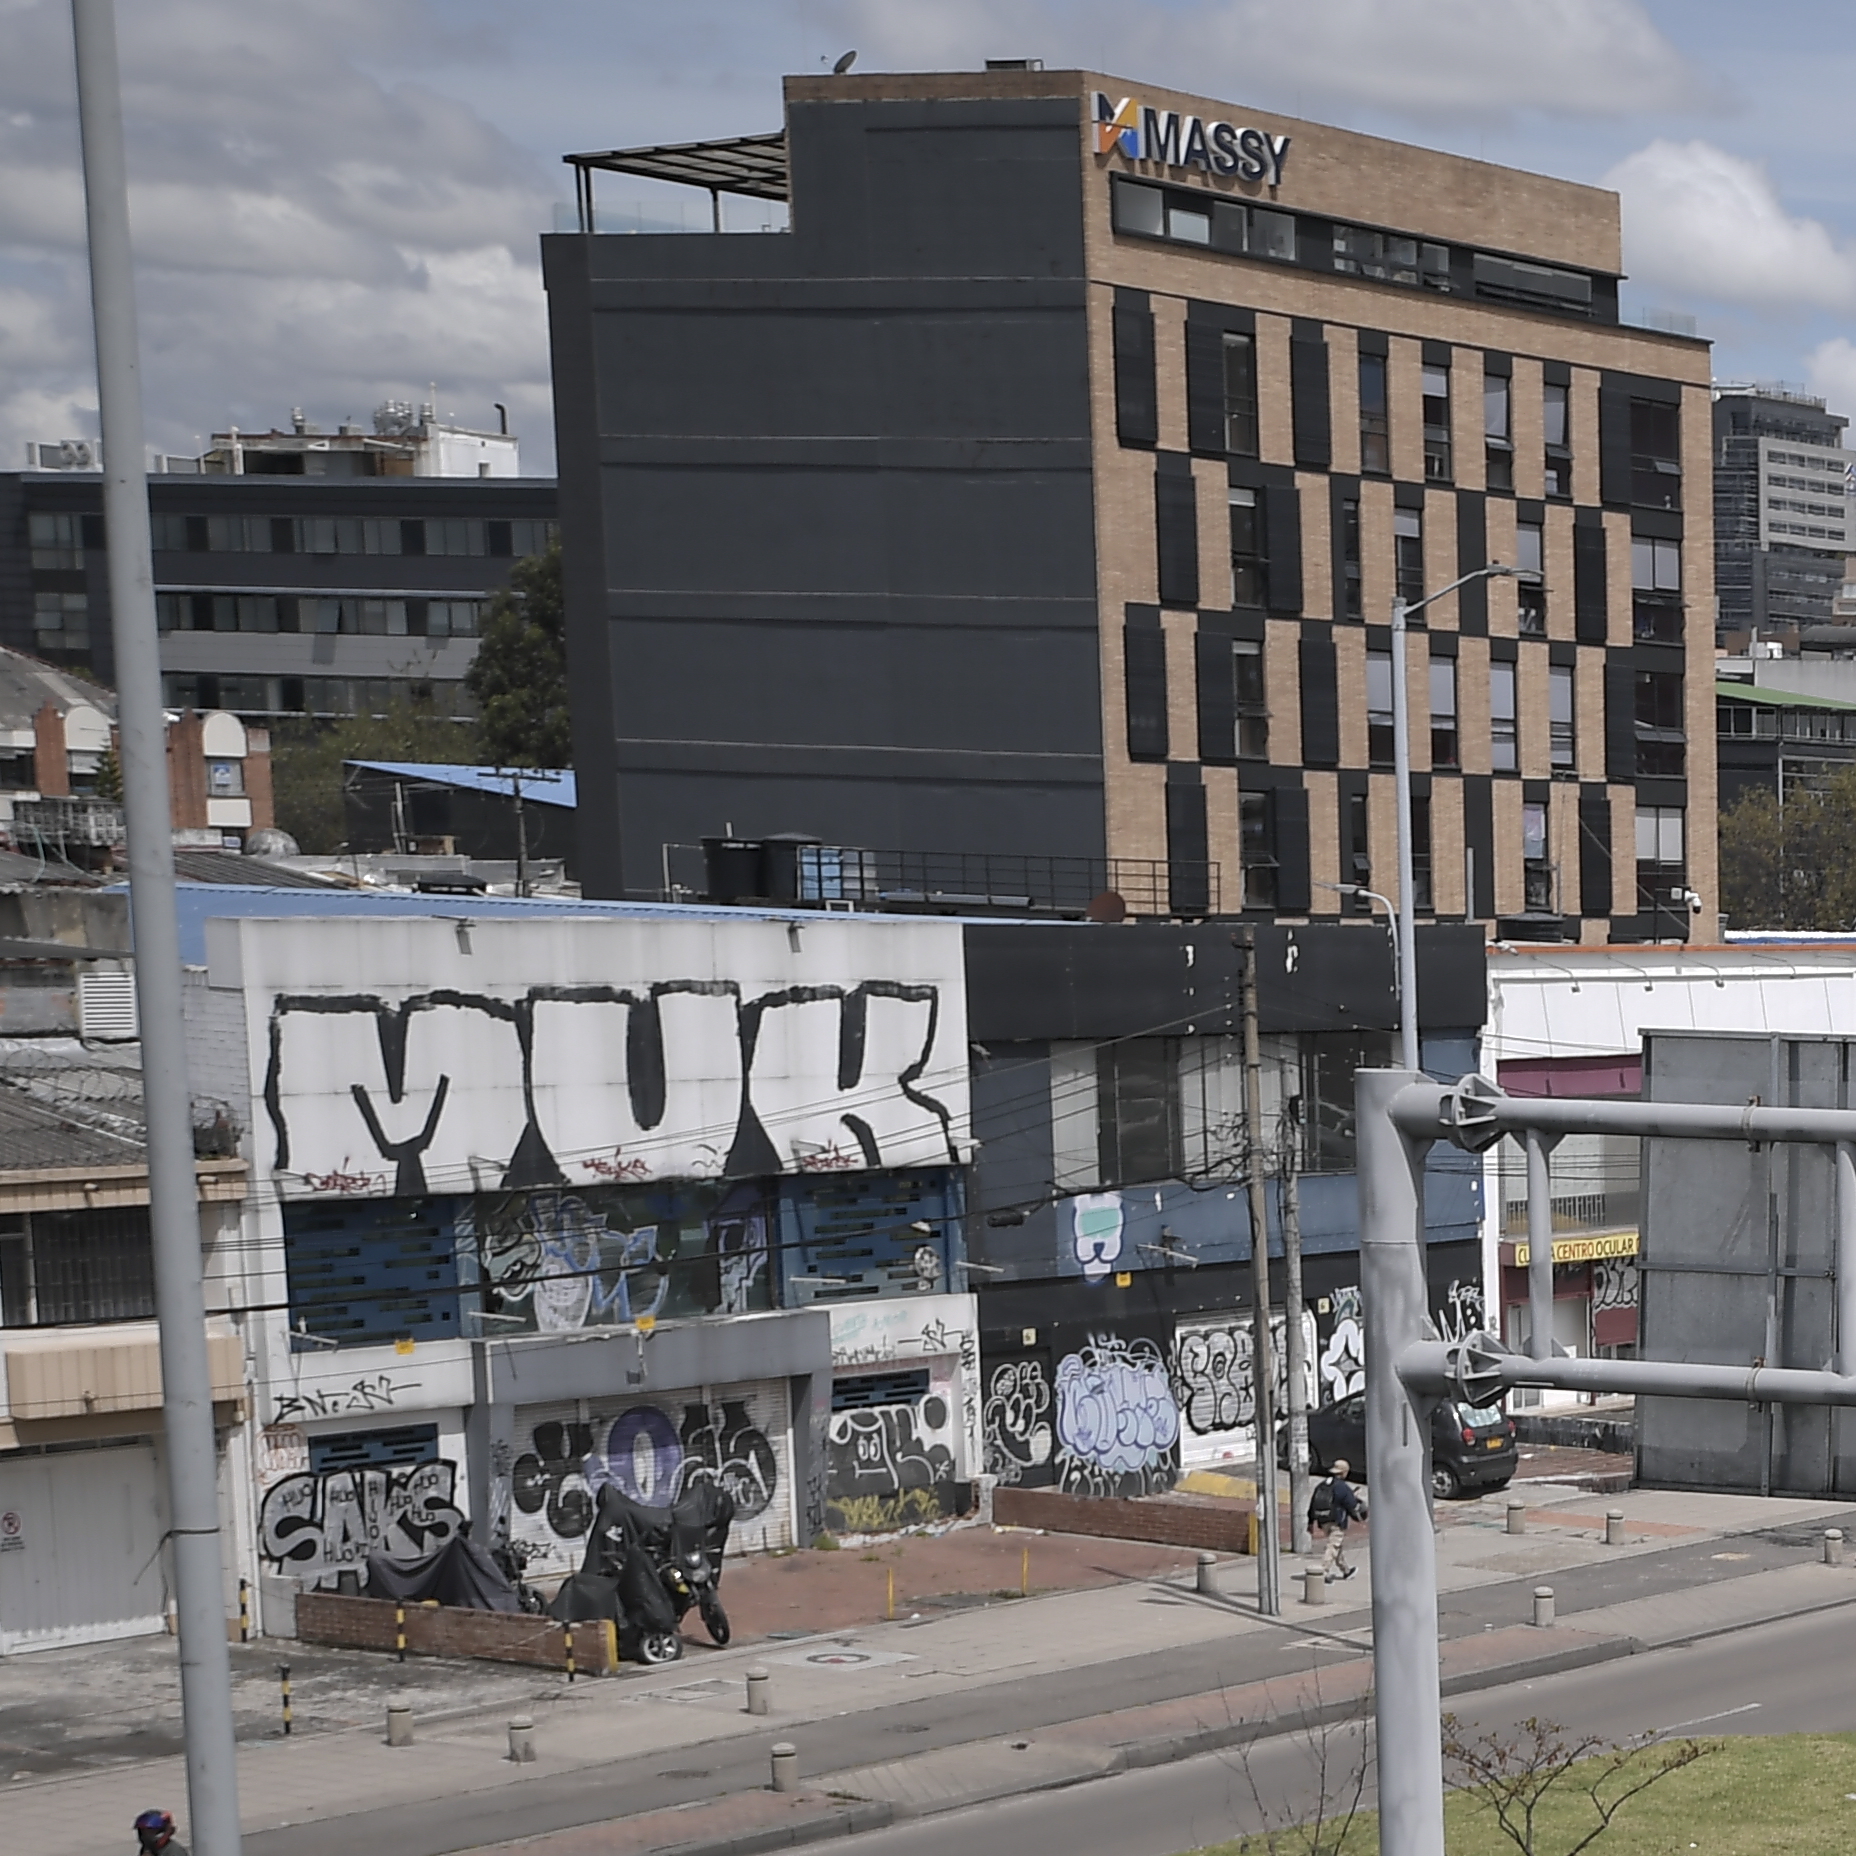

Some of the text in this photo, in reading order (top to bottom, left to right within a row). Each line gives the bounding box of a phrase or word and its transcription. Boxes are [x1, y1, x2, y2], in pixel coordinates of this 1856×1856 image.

[1138, 104, 1291, 184] MASSY
[1557, 1241, 1595, 1260] CENTRO
[1595, 1237, 1634, 1257] OCULAR
